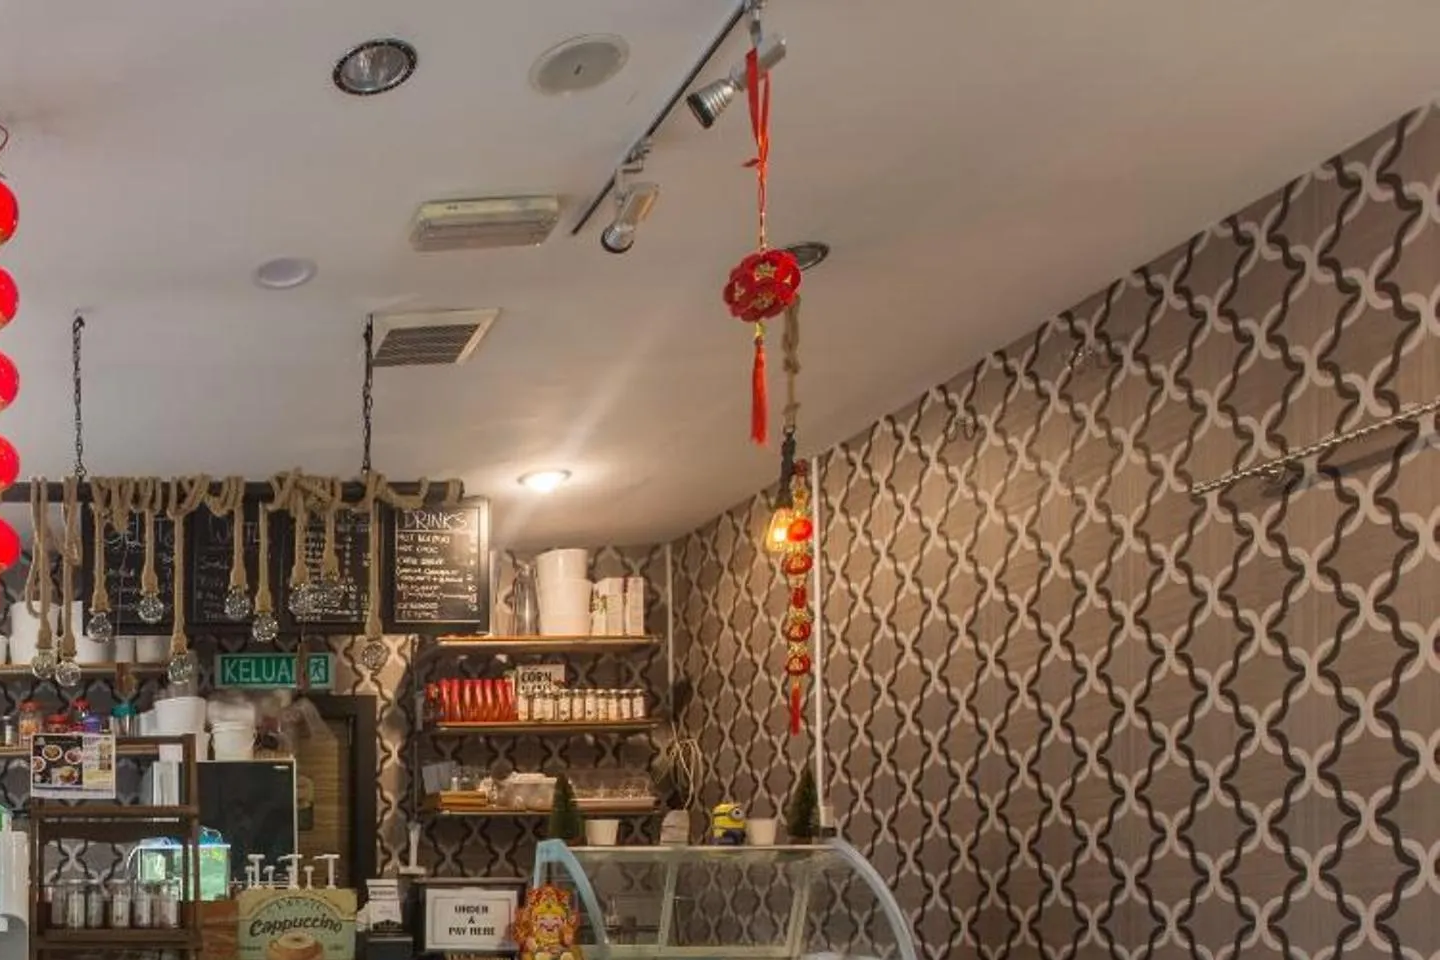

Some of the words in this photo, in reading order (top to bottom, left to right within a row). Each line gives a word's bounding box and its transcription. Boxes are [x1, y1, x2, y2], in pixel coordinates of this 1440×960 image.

[404, 510, 468, 531] DRINKS
[224, 659, 297, 683] KELUA
[454, 905, 489, 914] ORDER
[250, 913, 343, 937] Cappuccino
[449, 926, 467, 936] PAY
[470, 927, 495, 936] HERE
